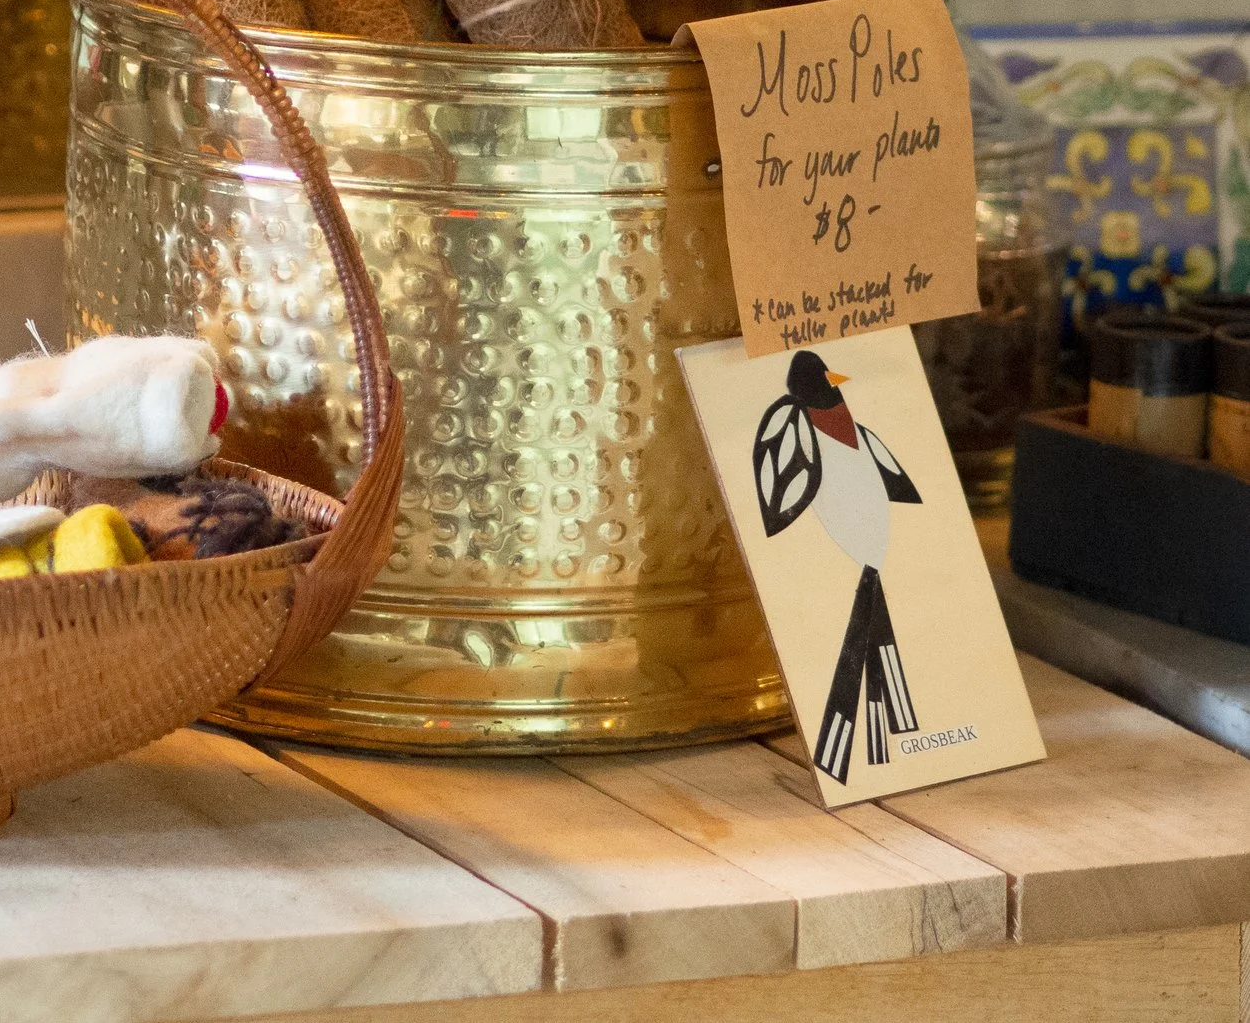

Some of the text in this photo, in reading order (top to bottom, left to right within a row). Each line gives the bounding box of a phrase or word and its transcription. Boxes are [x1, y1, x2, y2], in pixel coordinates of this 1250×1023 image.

[740, 13, 923, 118] Moss Poles
[756, 110, 941, 206] for your plants
[802, 290, 822, 314] be
[827, 271, 892, 312] stacked
[903, 262, 934, 295] for
[839, 299, 896, 338] plants
[900, 725, 979, 755] GROSBEAK
